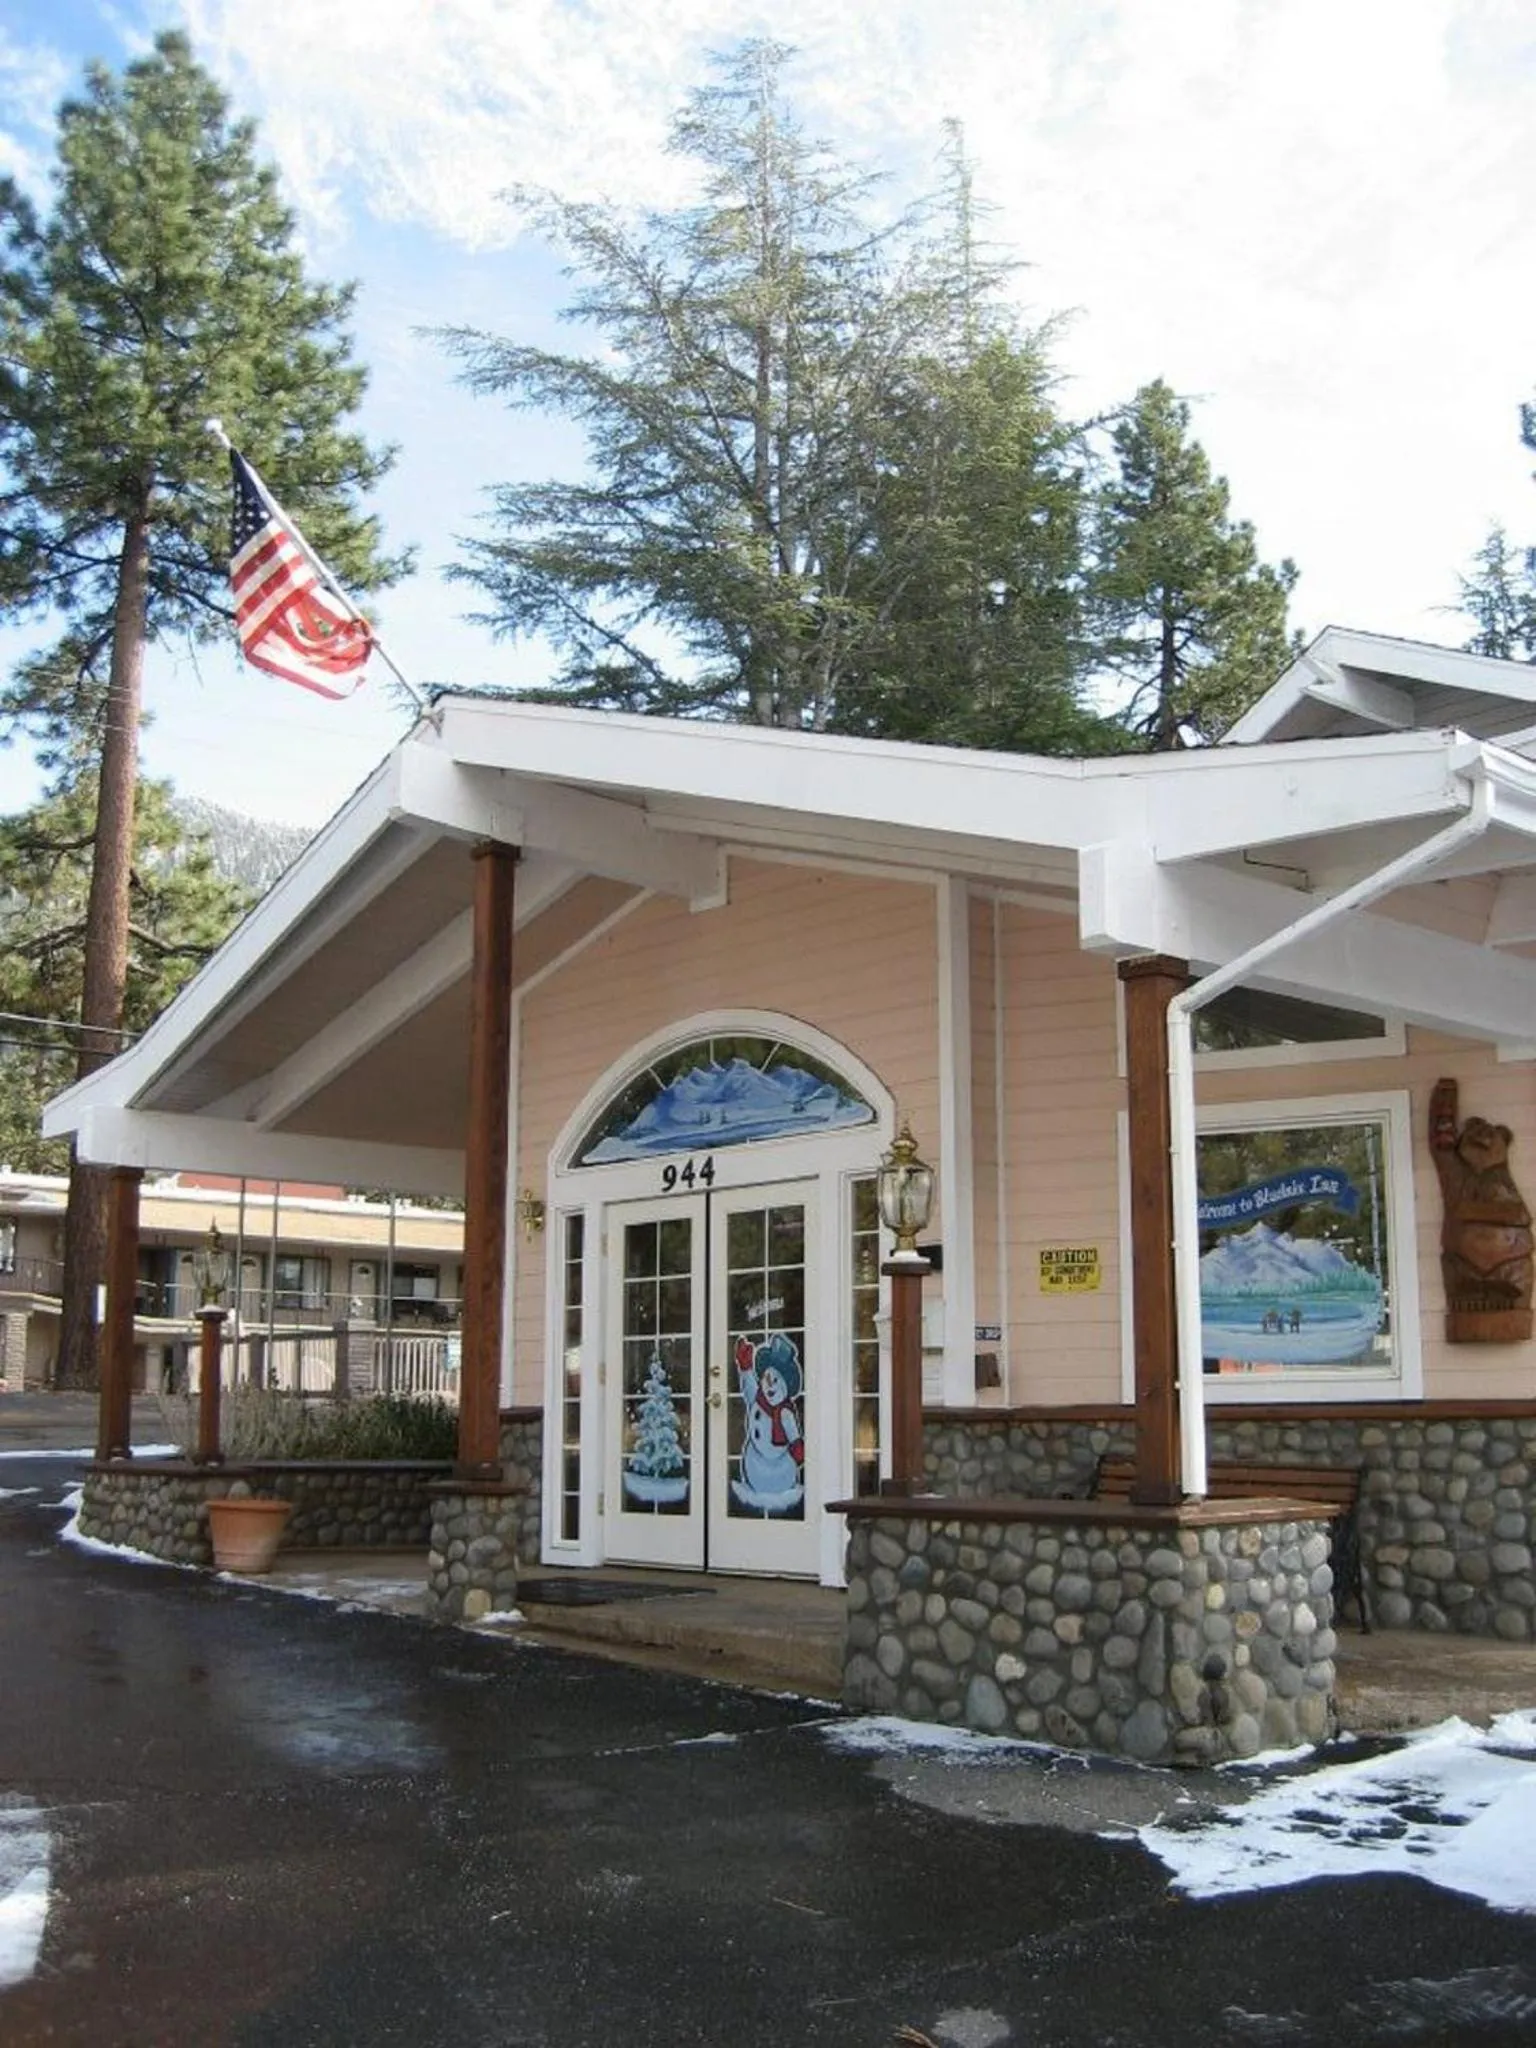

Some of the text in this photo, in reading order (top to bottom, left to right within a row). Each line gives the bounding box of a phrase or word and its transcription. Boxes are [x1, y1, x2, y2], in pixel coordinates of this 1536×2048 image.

[661, 1155, 715, 1193] 944
[1240, 1198, 1253, 1213] to
[1309, 1174, 1340, 1194] Inn
[1041, 1249, 1096, 1264] CAUTION
